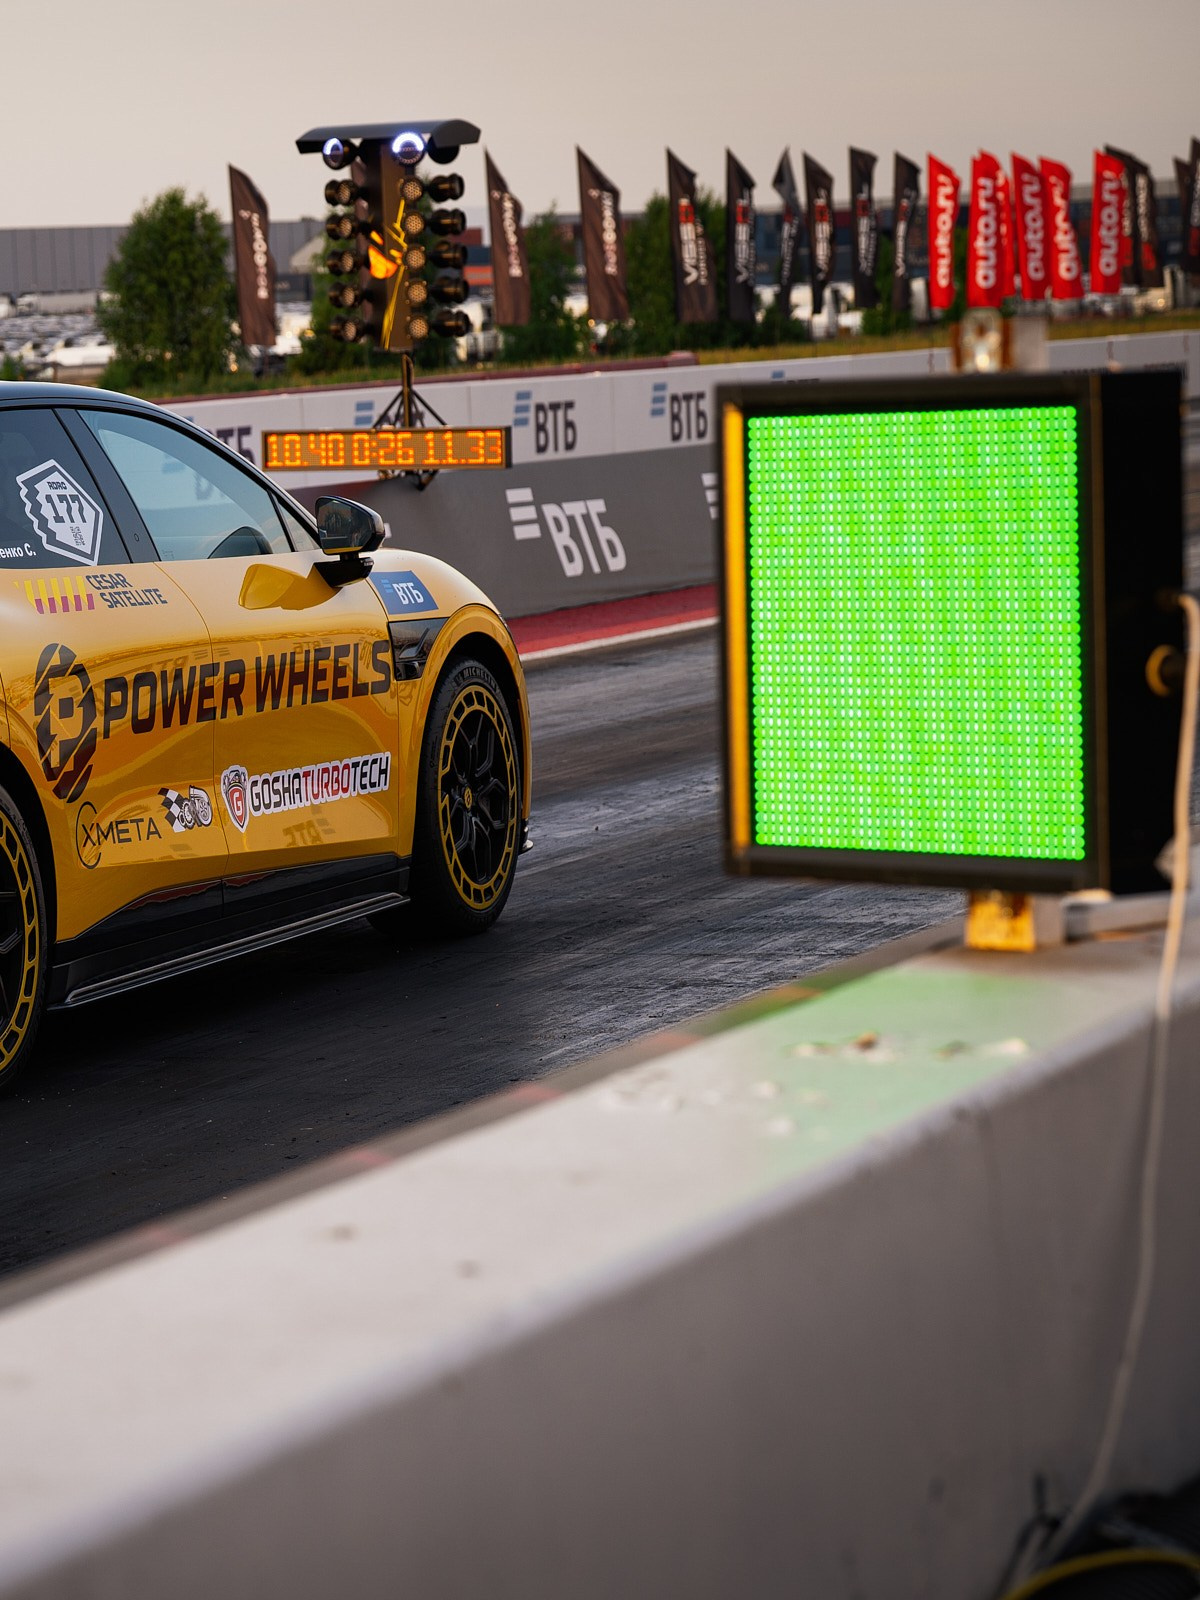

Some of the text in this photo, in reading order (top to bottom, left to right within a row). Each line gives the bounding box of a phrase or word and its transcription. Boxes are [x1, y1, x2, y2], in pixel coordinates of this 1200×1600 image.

[975, 177, 997, 289] auto.ru
[534, 401, 577, 454] ВТБ
[669, 391, 709, 442] ВТБ
[266, 430, 502, 467] 10.40 0:26 11.33
[45, 494, 87, 523] 177
[24, 542, 37, 556] С.
[541, 499, 627, 577] ВТБ
[86, 573, 133, 590] CESAR
[100, 589, 168, 609] SATELLITE
[397, 581, 425, 605] ВТБ
[102, 658, 246, 739] POWER
[255, 639, 392, 713] WHEELS
[249, 756, 389, 812] GOSHATURBOTECH
